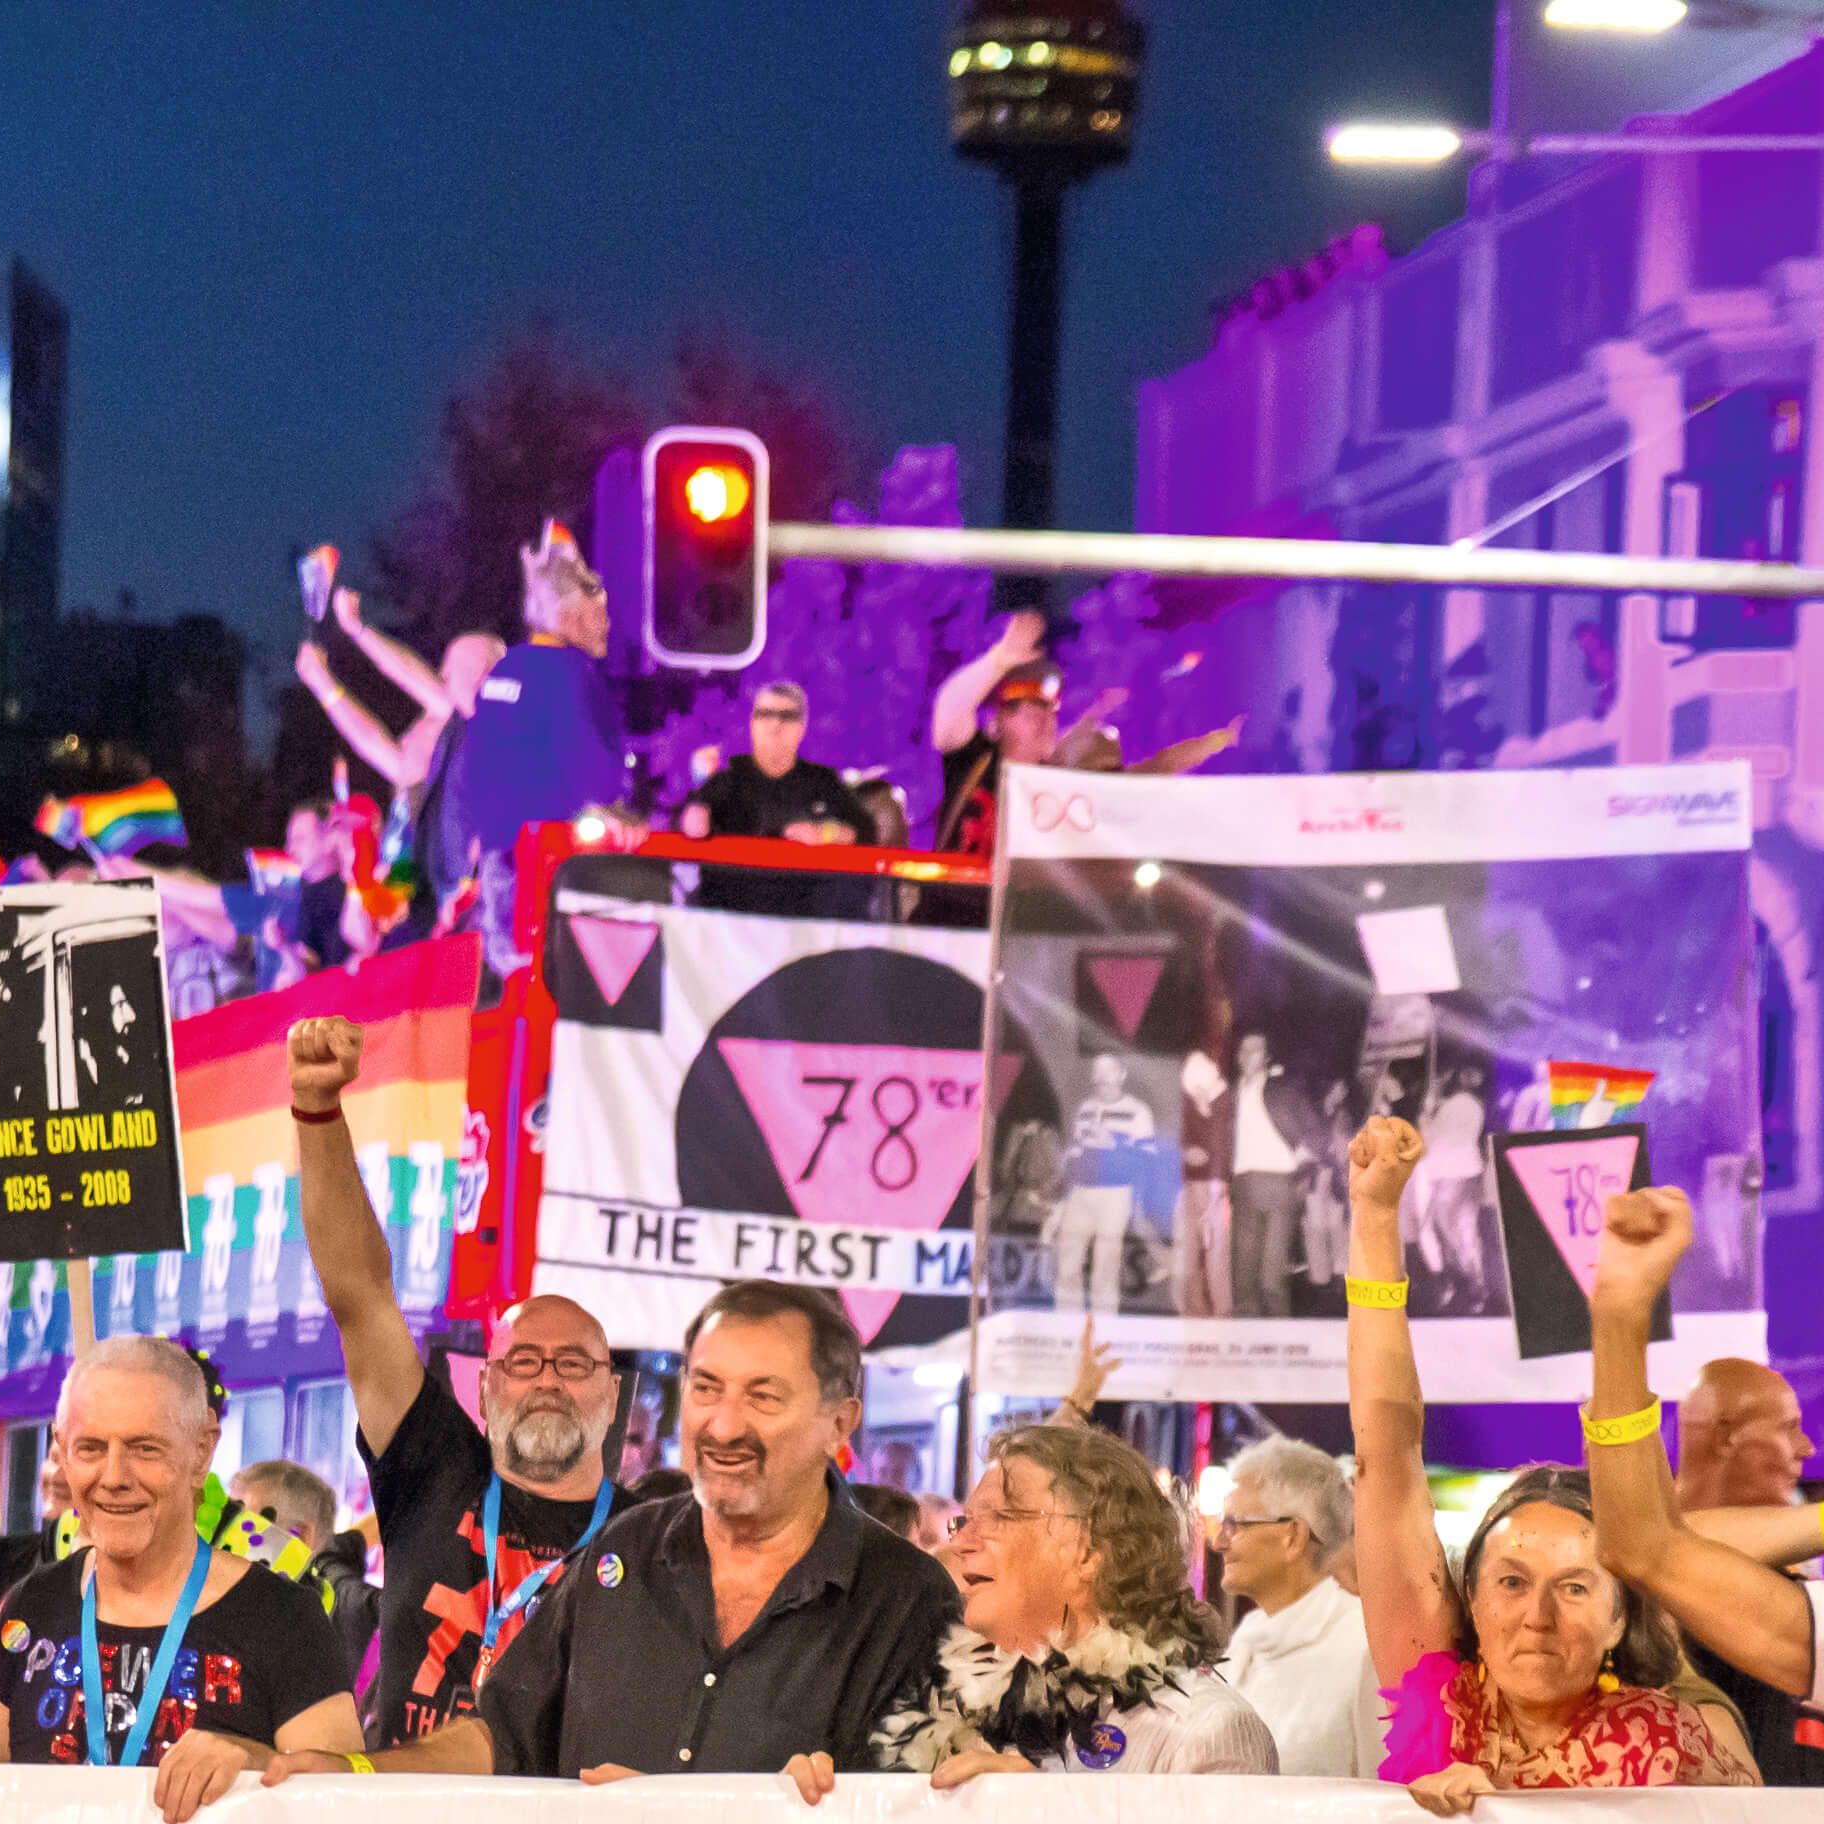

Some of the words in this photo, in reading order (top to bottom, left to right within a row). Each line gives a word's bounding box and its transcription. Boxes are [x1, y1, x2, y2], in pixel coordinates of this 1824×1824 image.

[45, 1109, 158, 1155] GOWLAND
[3, 1174, 52, 1212] 1935
[80, 1169, 132, 1207] 2008
[598, 1208, 700, 1266] THE
[733, 1223, 890, 1281] FIRST
